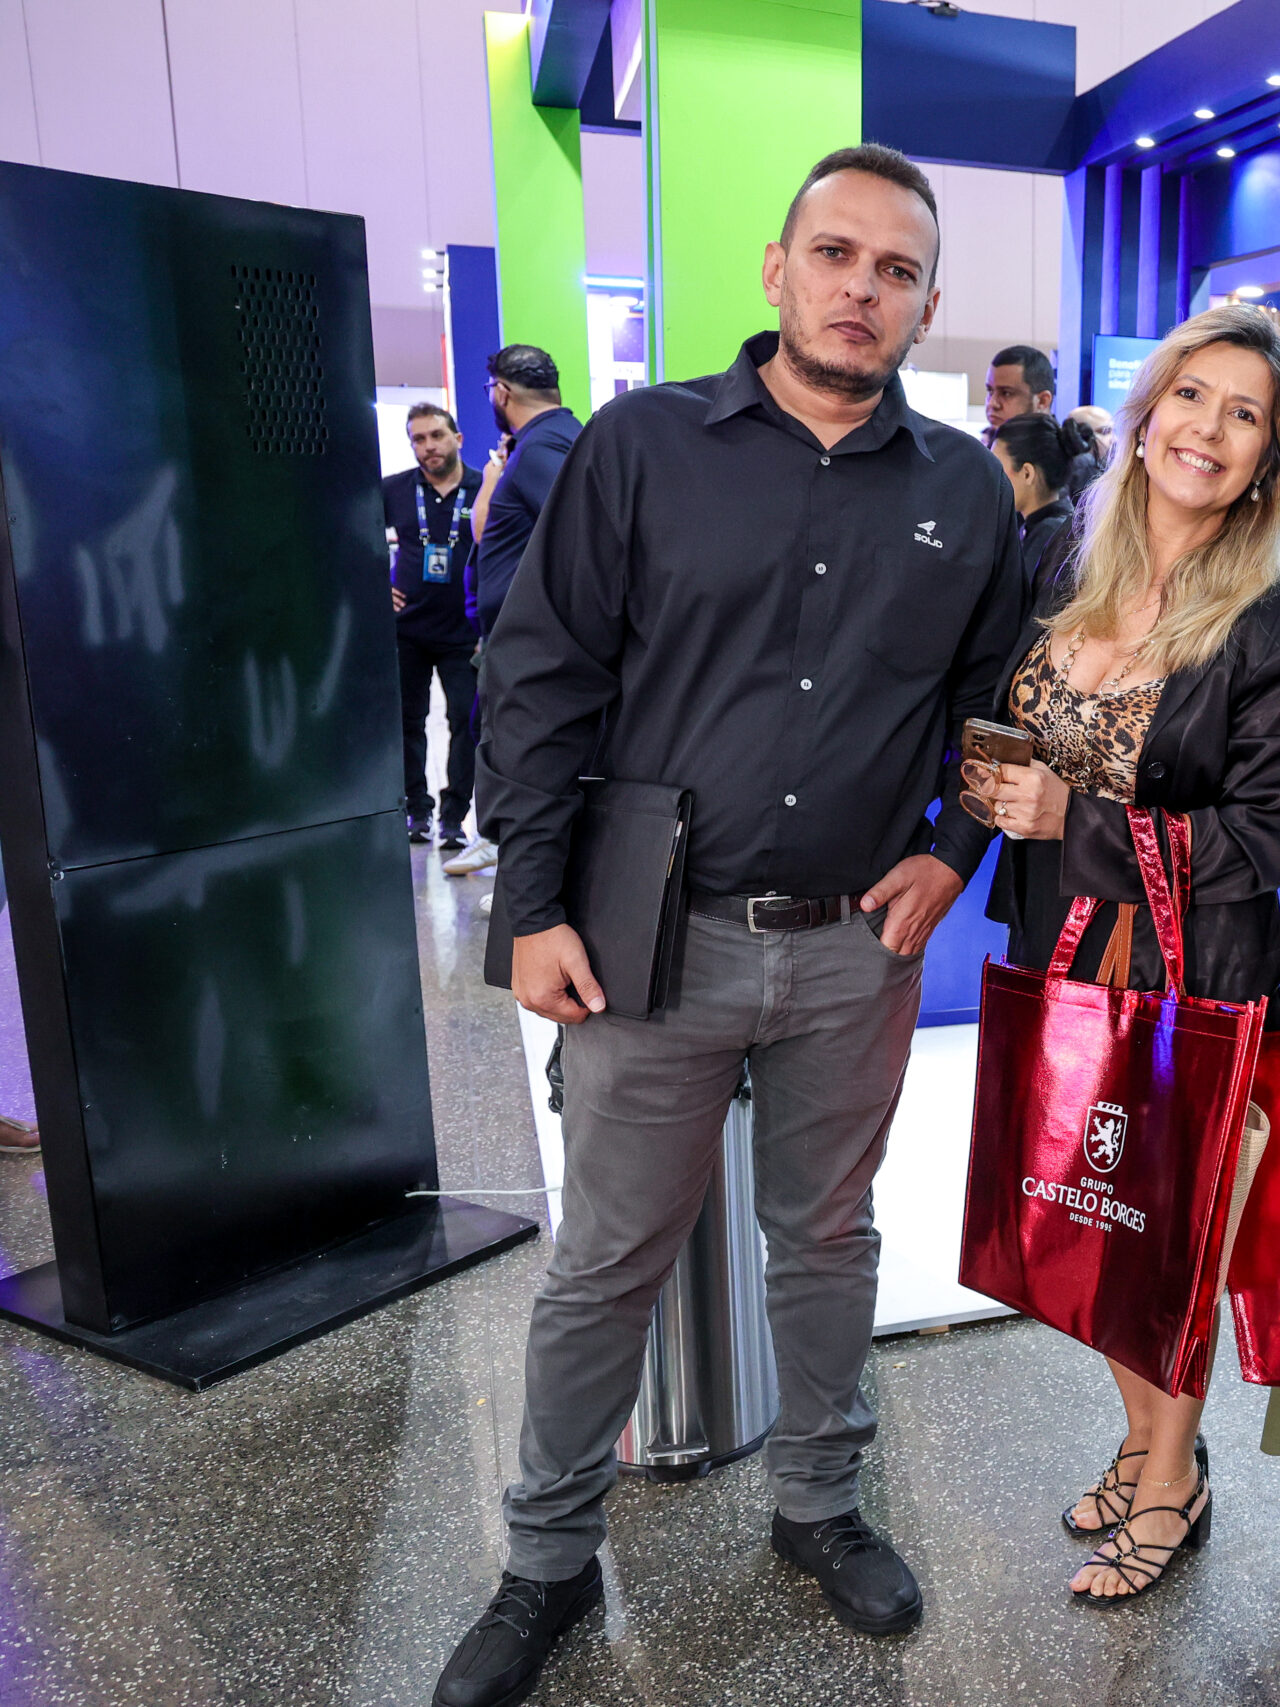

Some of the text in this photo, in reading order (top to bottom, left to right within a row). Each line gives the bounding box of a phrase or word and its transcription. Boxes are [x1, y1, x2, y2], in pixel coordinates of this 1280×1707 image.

[914, 532, 943, 549] SOLID
[1080, 1176, 1114, 1195] GRUPO
[1022, 1177, 1146, 1233] CASTELO BORGES
[1070, 1212, 1112, 1232] DESDE 1995
